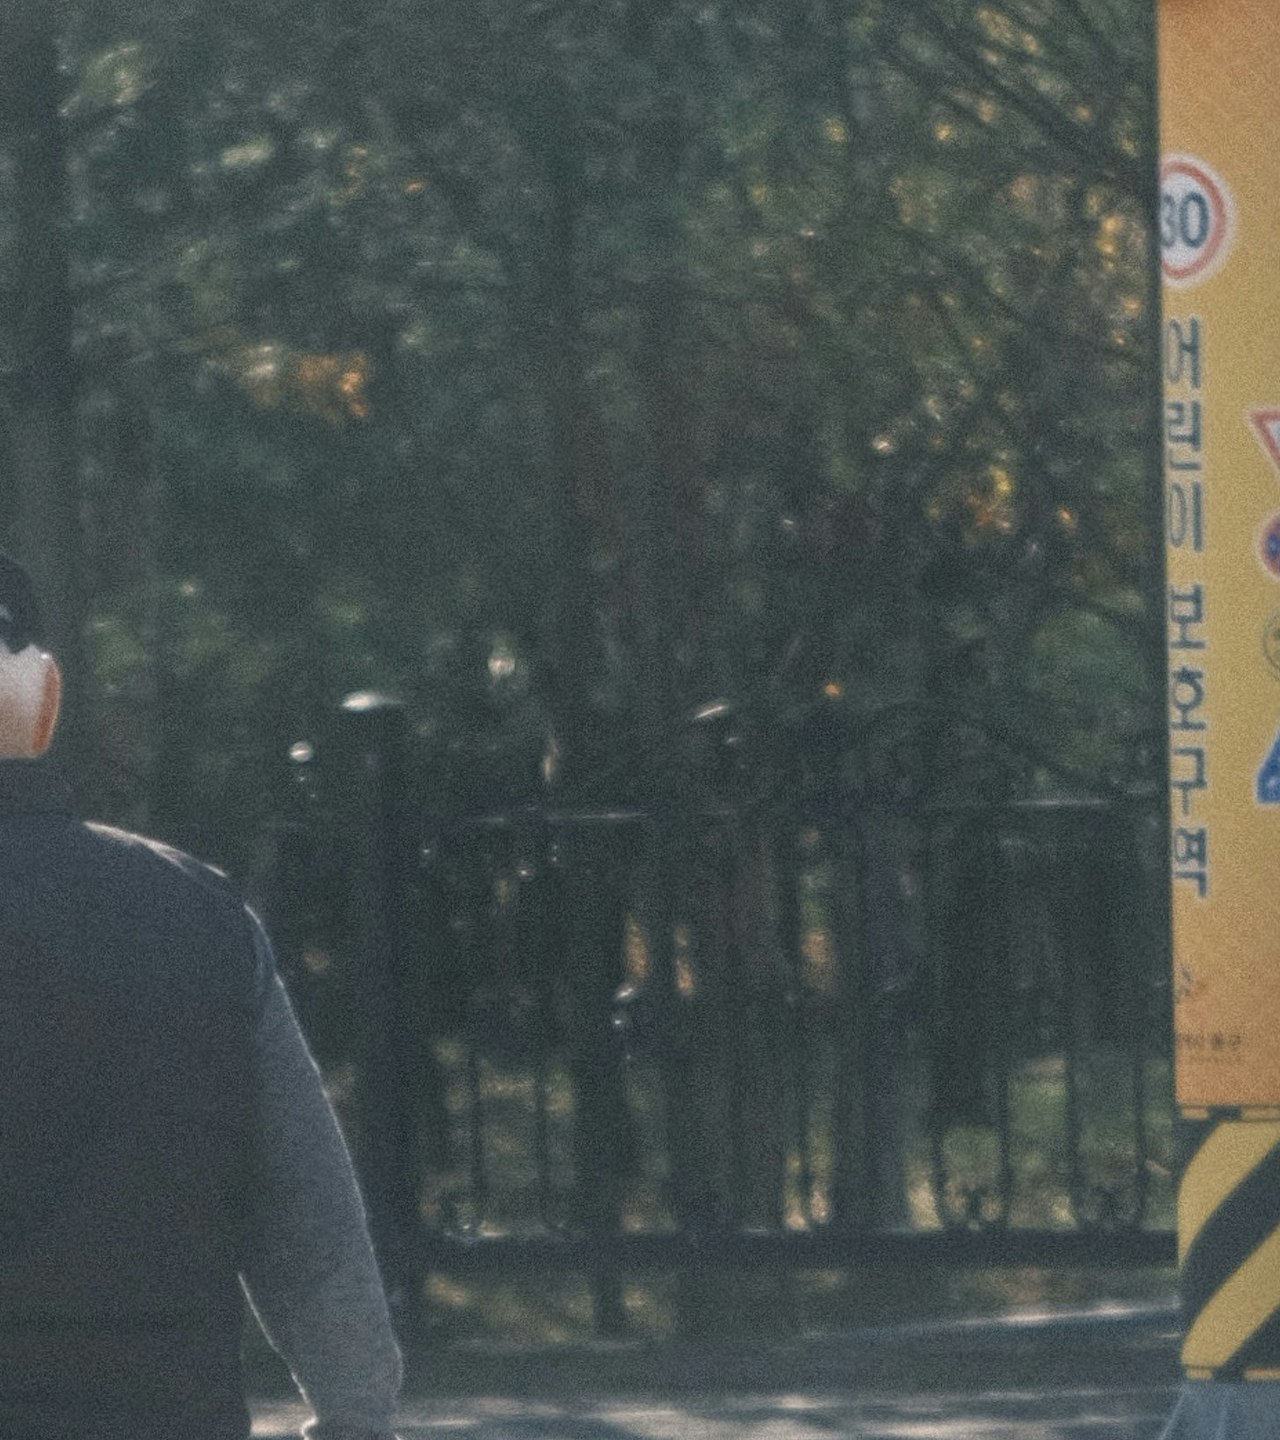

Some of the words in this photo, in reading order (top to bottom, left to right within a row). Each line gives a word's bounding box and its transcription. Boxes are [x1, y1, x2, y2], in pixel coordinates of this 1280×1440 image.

[1161, 190, 1210, 249] 30
[1165, 316, 1202, 554] 어린이
[1170, 584, 1209, 899] 보호구역
